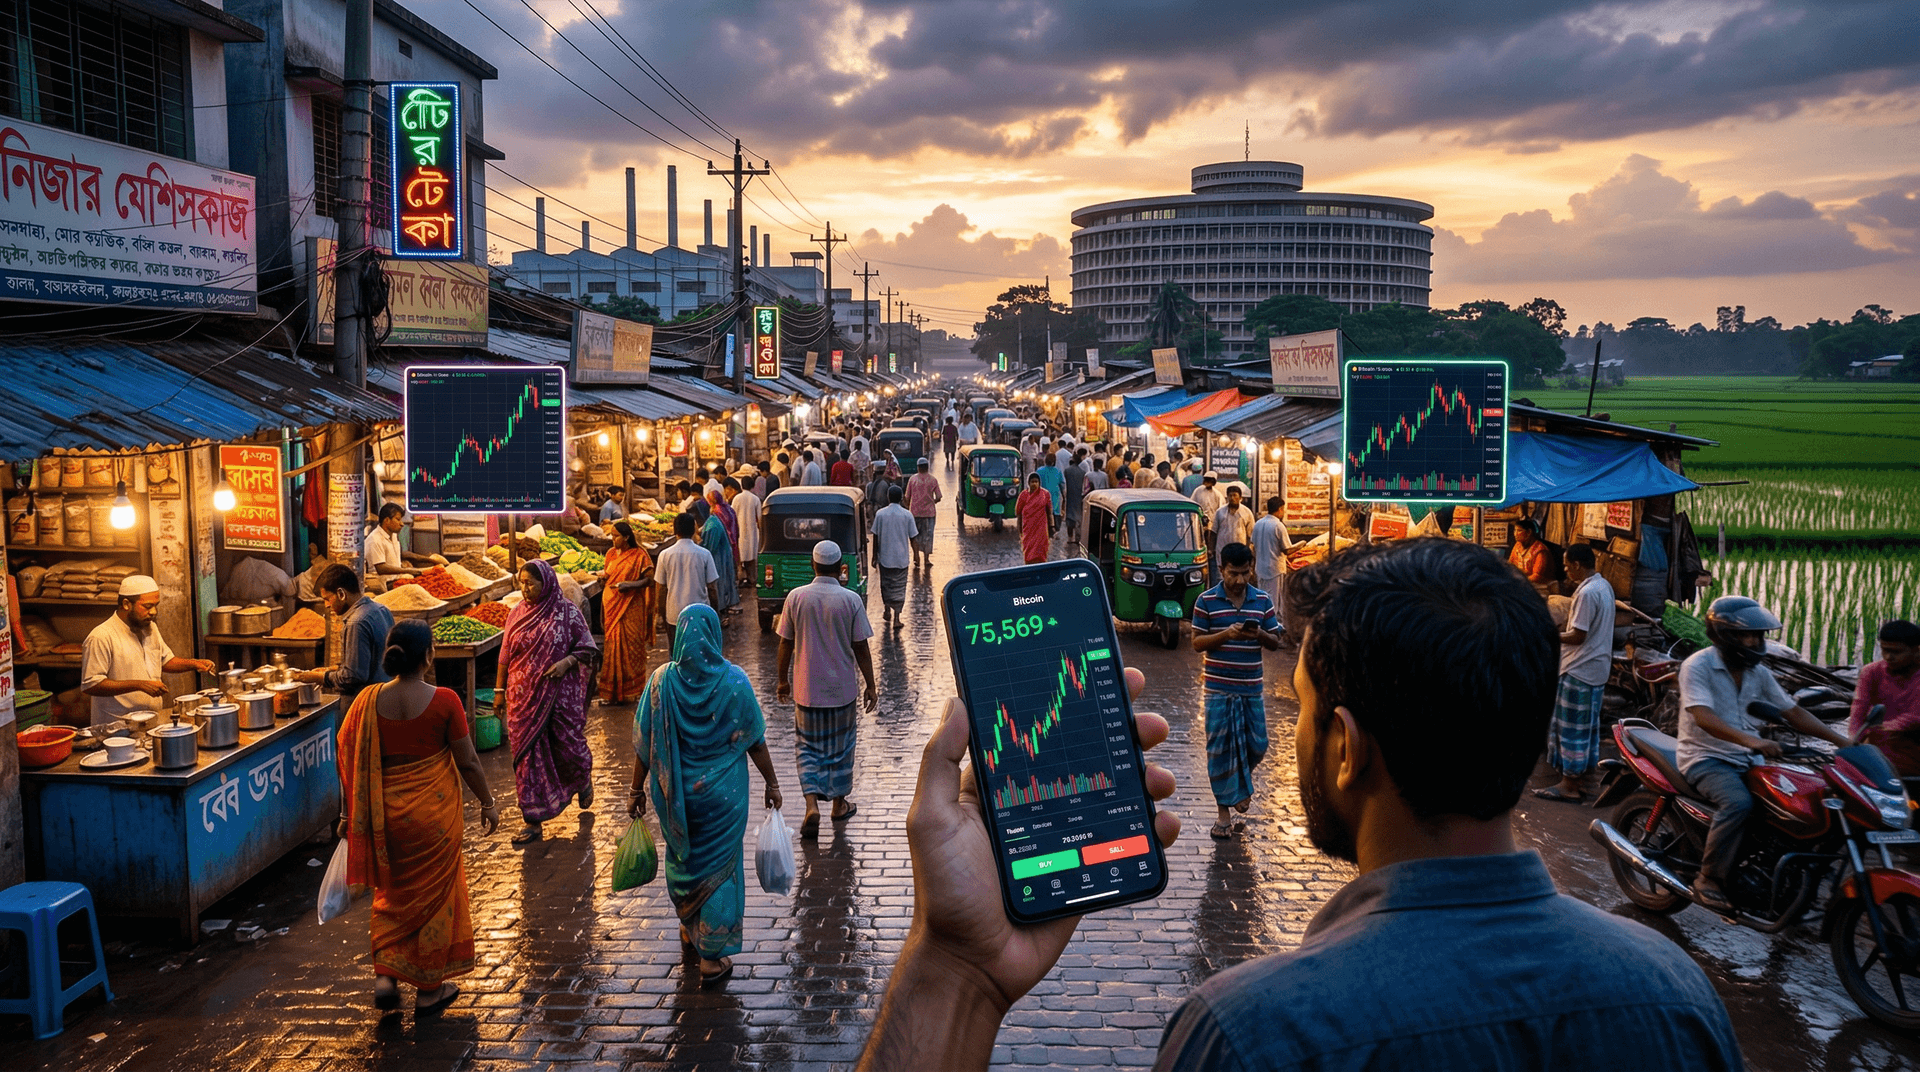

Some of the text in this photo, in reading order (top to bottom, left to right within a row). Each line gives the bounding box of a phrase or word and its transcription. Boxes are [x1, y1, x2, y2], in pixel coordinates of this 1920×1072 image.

[1012, 594, 1044, 607] Bitcoin
[965, 614, 1044, 646] 75,569
[1038, 860, 1053, 869] BUY
